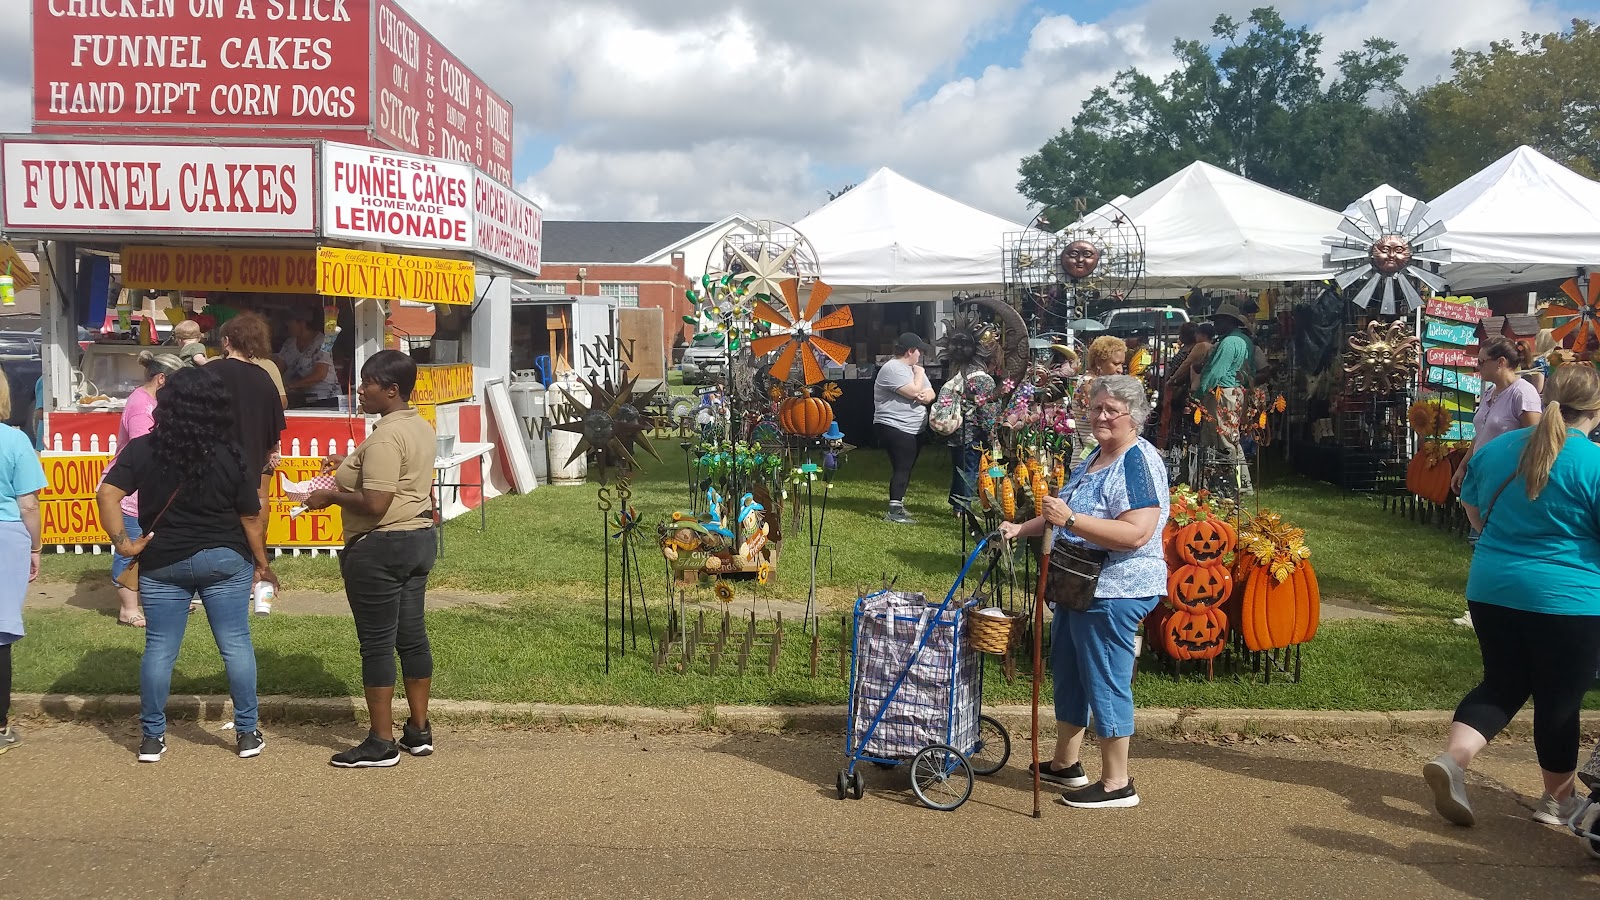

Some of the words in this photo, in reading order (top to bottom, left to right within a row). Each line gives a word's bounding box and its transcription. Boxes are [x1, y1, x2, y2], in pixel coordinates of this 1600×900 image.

[48, 0, 175, 18] CHICKEN
[189, 0, 222, 18] ON
[236, 0, 256, 20] A
[267, 0, 351, 22] STICK
[71, 34, 207, 68] FUNNEL
[220, 37, 332, 70] CAKES
[379, 4, 419, 72] CHICKEN
[393, 63, 403, 89] ON
[404, 72, 409, 94] A
[440, 58, 470, 110] CORN
[49, 81, 125, 114] HAND
[135, 82, 200, 115] DIP'T
[210, 84, 281, 116] CORN
[292, 84, 356, 118] DOGS
[426, 43, 435, 156] LEMONADE
[380, 87, 420, 149] STICK
[486, 94, 510, 142] FUNNEL
[442, 127, 472, 163] DOGS
[492, 136, 506, 161] FRESH
[369, 155, 436, 173] FRESH
[21, 159, 170, 211] FUNNEL
[179, 162, 297, 215] CAKES
[334, 161, 407, 200] FUNNEL
[412, 172, 466, 208] CAKES
[335, 205, 466, 242] LEMONADE
[361, 197, 444, 215] HOMEMADE
[475, 177, 508, 225] CHICKEN
[510, 196, 518, 231] ON
[518, 203, 523, 233] A
[524, 206, 542, 242] STICK
[478, 219, 494, 251] HAND
[494, 227, 513, 259] DIPPED
[513, 236, 526, 264] CORN
[526, 242, 539, 269] DOGS
[127, 252, 170, 283] HAND
[175, 253, 232, 285] DIPPED
[240, 255, 280, 288] CORN
[286, 255, 316, 287] DOG
[372, 256, 393, 266] ICE
[398, 258, 432, 270] COLD
[322, 260, 409, 298] FOUNTAIN
[413, 269, 470, 303] DRINKS
[1430, 324, 1454, 338] Welcome
[580, 343, 602, 369] N
[616, 337, 637, 363] N
[1430, 350, 1444, 361] Gone
[522, 416, 546, 441] W
[597, 487, 613, 512] S
[68, 535, 110, 543] PEPPER
[281, 514, 344, 542] TE
